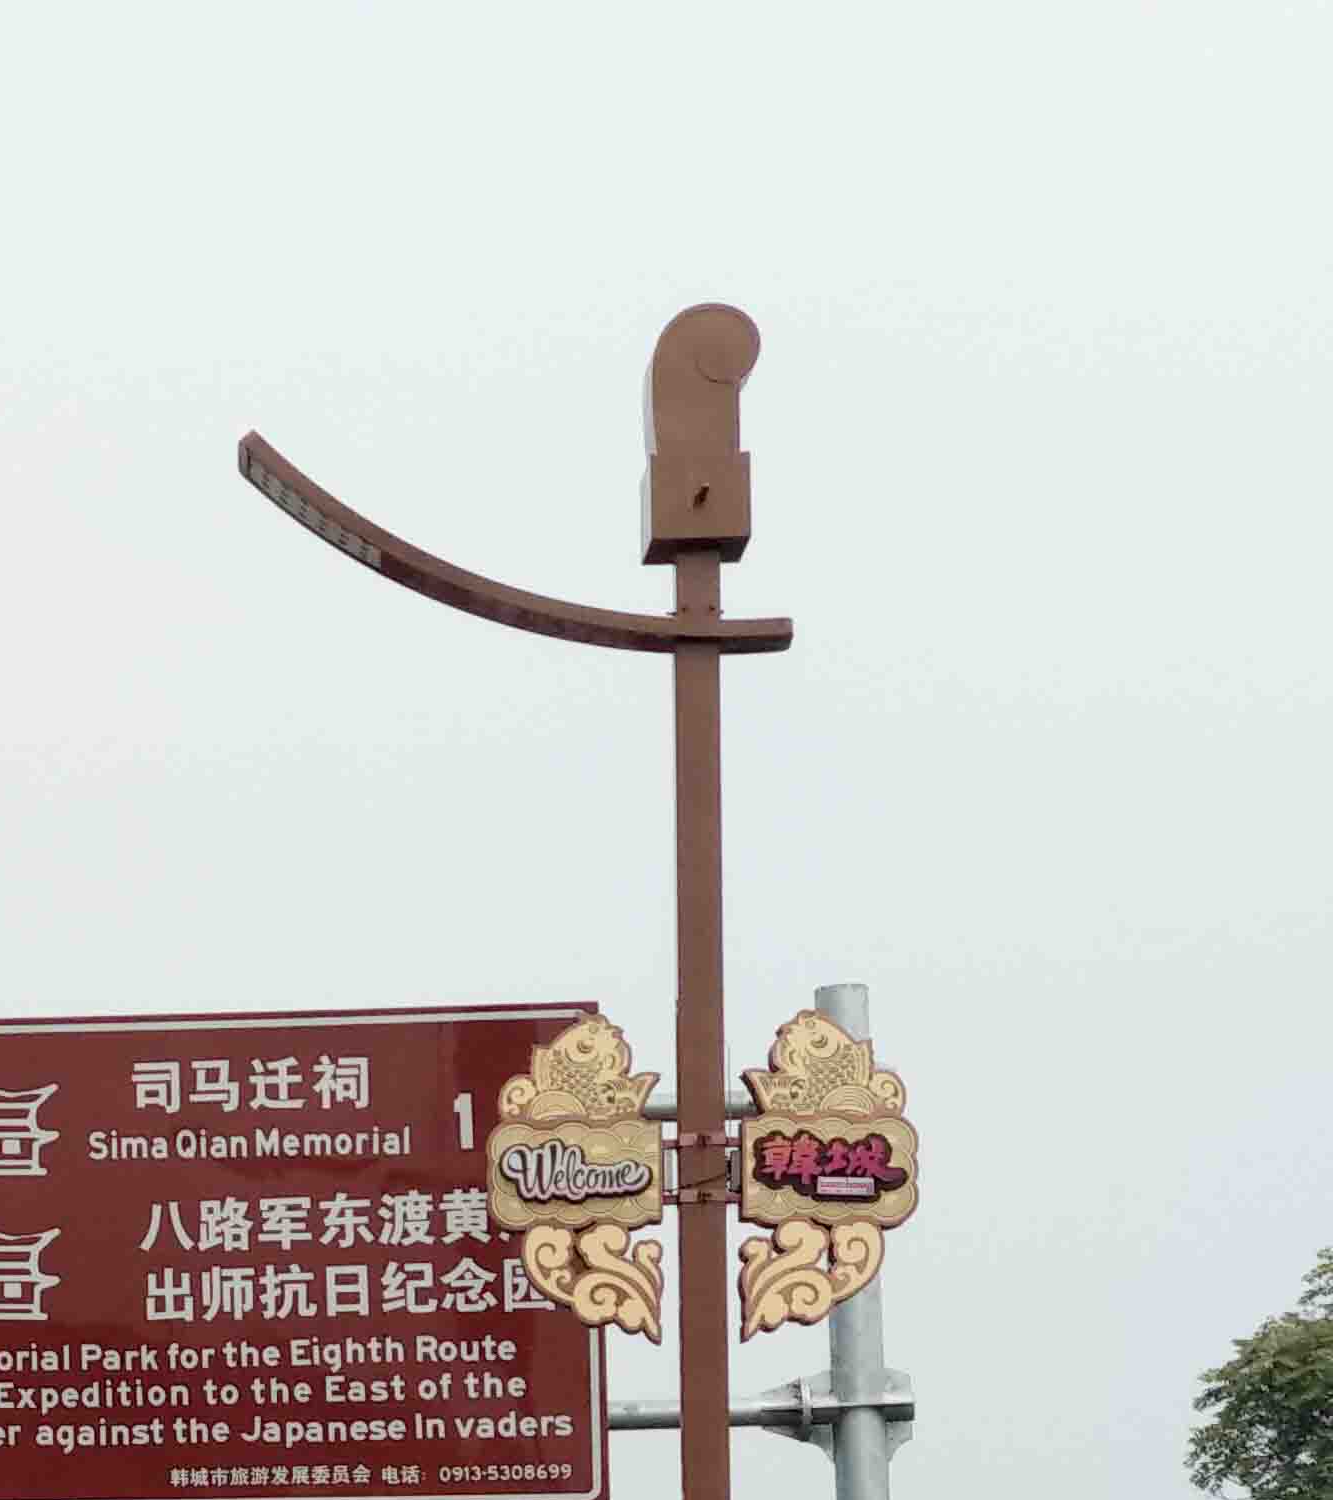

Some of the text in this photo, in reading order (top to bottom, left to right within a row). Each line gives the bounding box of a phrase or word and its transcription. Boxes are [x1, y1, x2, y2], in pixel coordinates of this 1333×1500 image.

[132, 1055, 370, 1114] 司马迁祠
[88, 1125, 411, 1161] Sima Qian Memorial
[501, 1140, 651, 1200] Welcome
[139, 1187, 511, 1252] 八路军东渡黄
[81, 1343, 159, 1371] Park
[167, 1342, 215, 1370] for
[223, 1341, 281, 1368] the
[290, 1337, 405, 1372] Eighth
[416, 1335, 517, 1363] Route
[203, 1379, 239, 1406] to
[250, 1376, 312, 1404] the
[325, 1374, 406, 1402] East
[418, 1372, 452, 1399] of
[464, 1371, 527, 1398] the
[35, 1417, 164, 1455] against
[173, 1417, 230, 1444] the
[241, 1414, 406, 1448] Japanese
[439, 1464, 573, 1483] 0913-5308699
